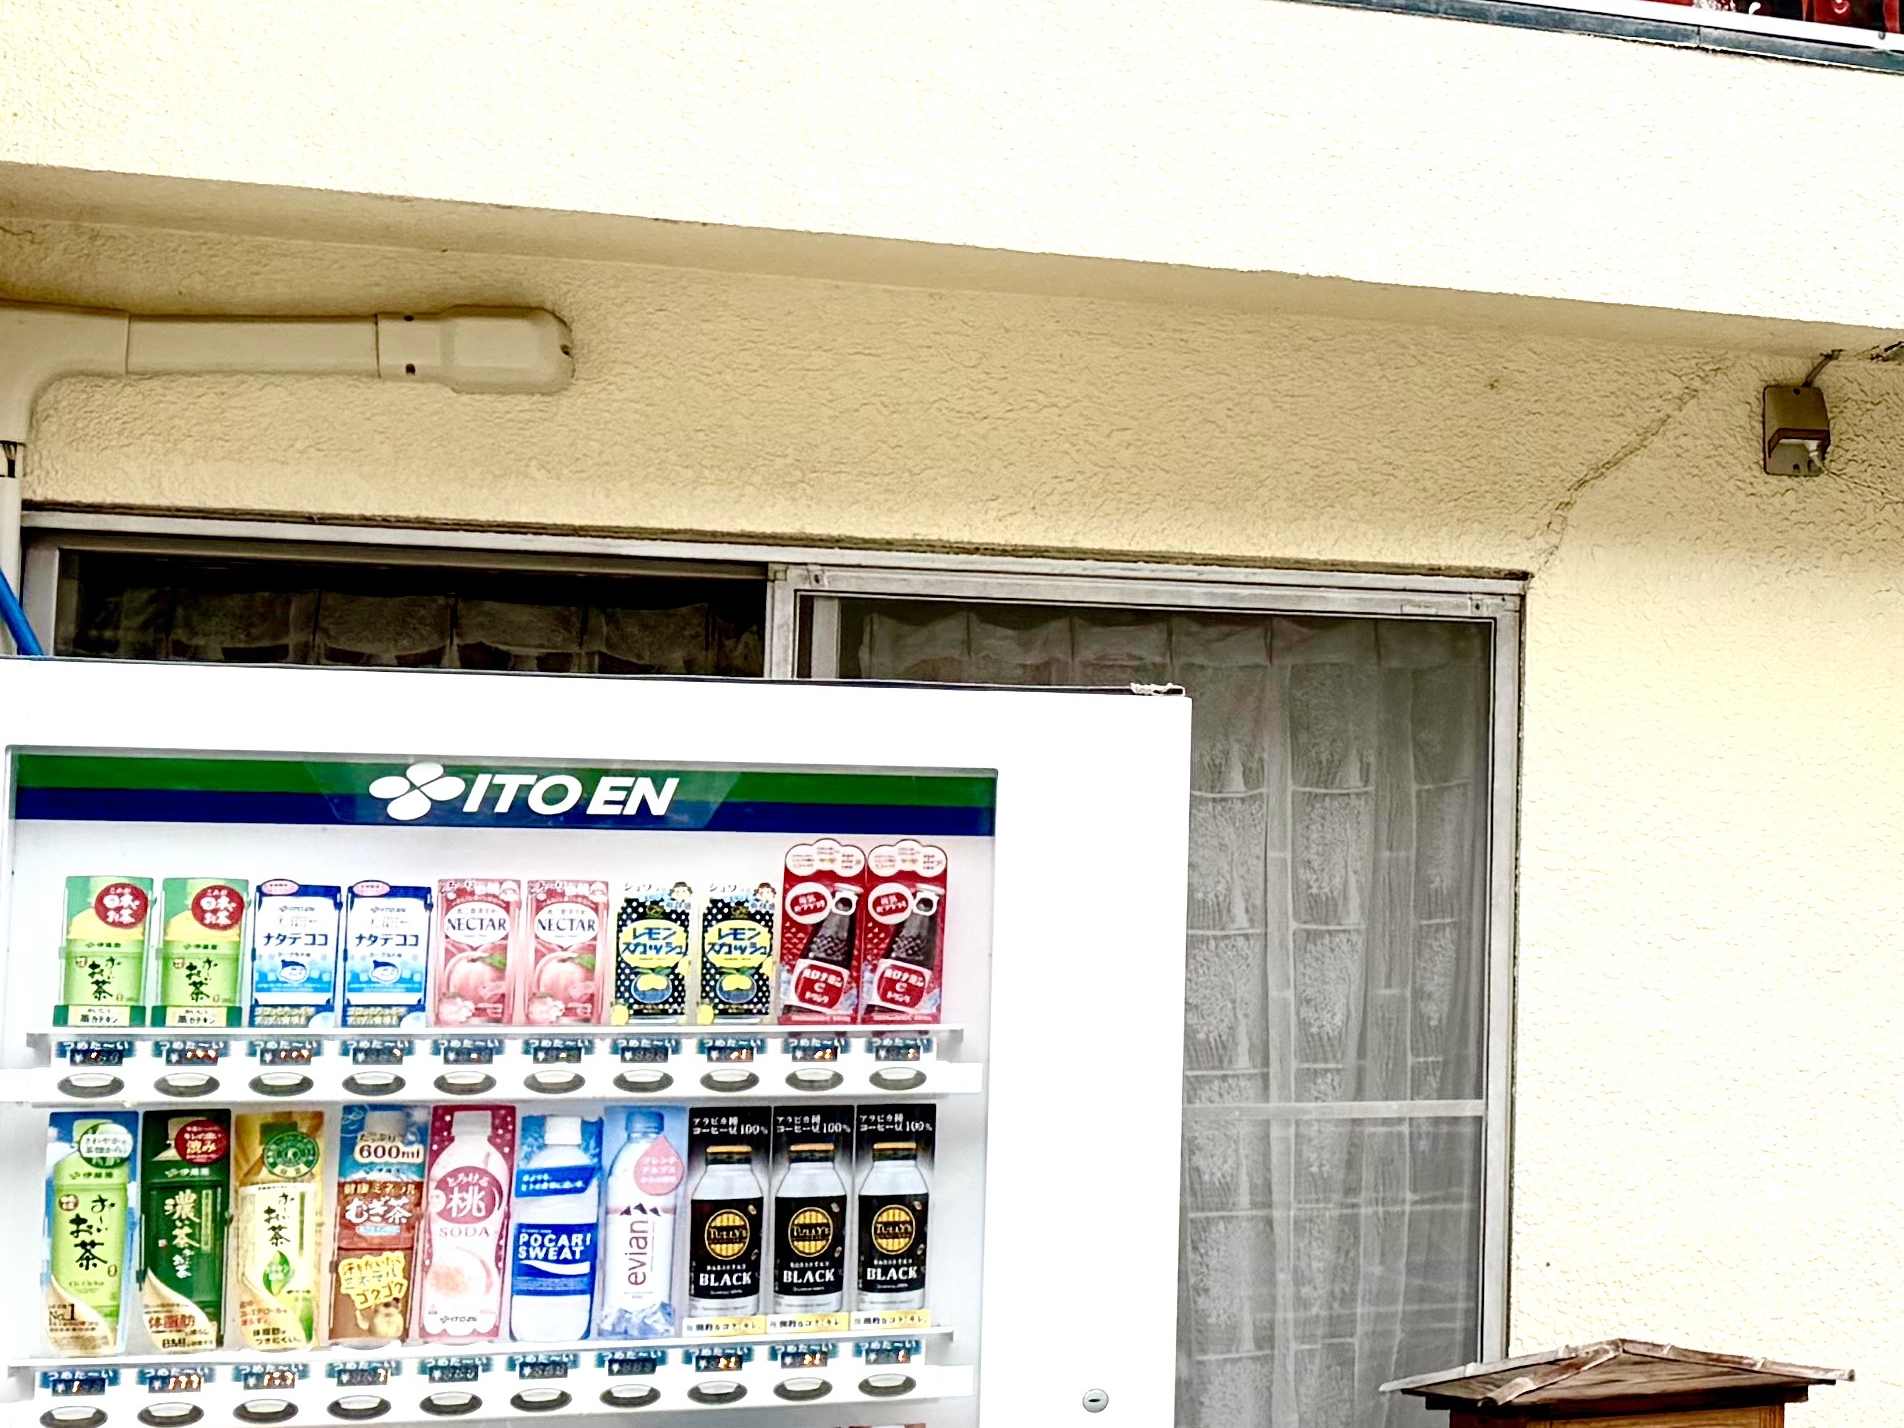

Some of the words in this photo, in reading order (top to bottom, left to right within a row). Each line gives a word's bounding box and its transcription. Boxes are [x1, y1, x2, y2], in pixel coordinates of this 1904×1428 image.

[462, 772, 583, 815] ITO
[596, 776, 681, 817] EN
[446, 917, 507, 933] NECTAR
[536, 918, 596, 934] NECTAR
[263, 933, 328, 947] ナタデココ
[355, 933, 419, 947] ナタデココ
[632, 927, 677, 941] レモン
[718, 927, 761, 941] レモン
[359, 1144, 422, 1159] 600ml
[449, 1185, 486, 1219] 桃
[345, 1196, 413, 1224] むぎ茶
[439, 1227, 490, 1238] SODA
[518, 1233, 592, 1246] POCARI
[69, 1215, 108, 1270] お茶
[518, 1245, 584, 1260] SWEAT
[625, 1219, 649, 1286] evian
[699, 1272, 752, 1287] BLACK
[783, 1269, 835, 1284] BLACK
[867, 1266, 918, 1280] BLACK
